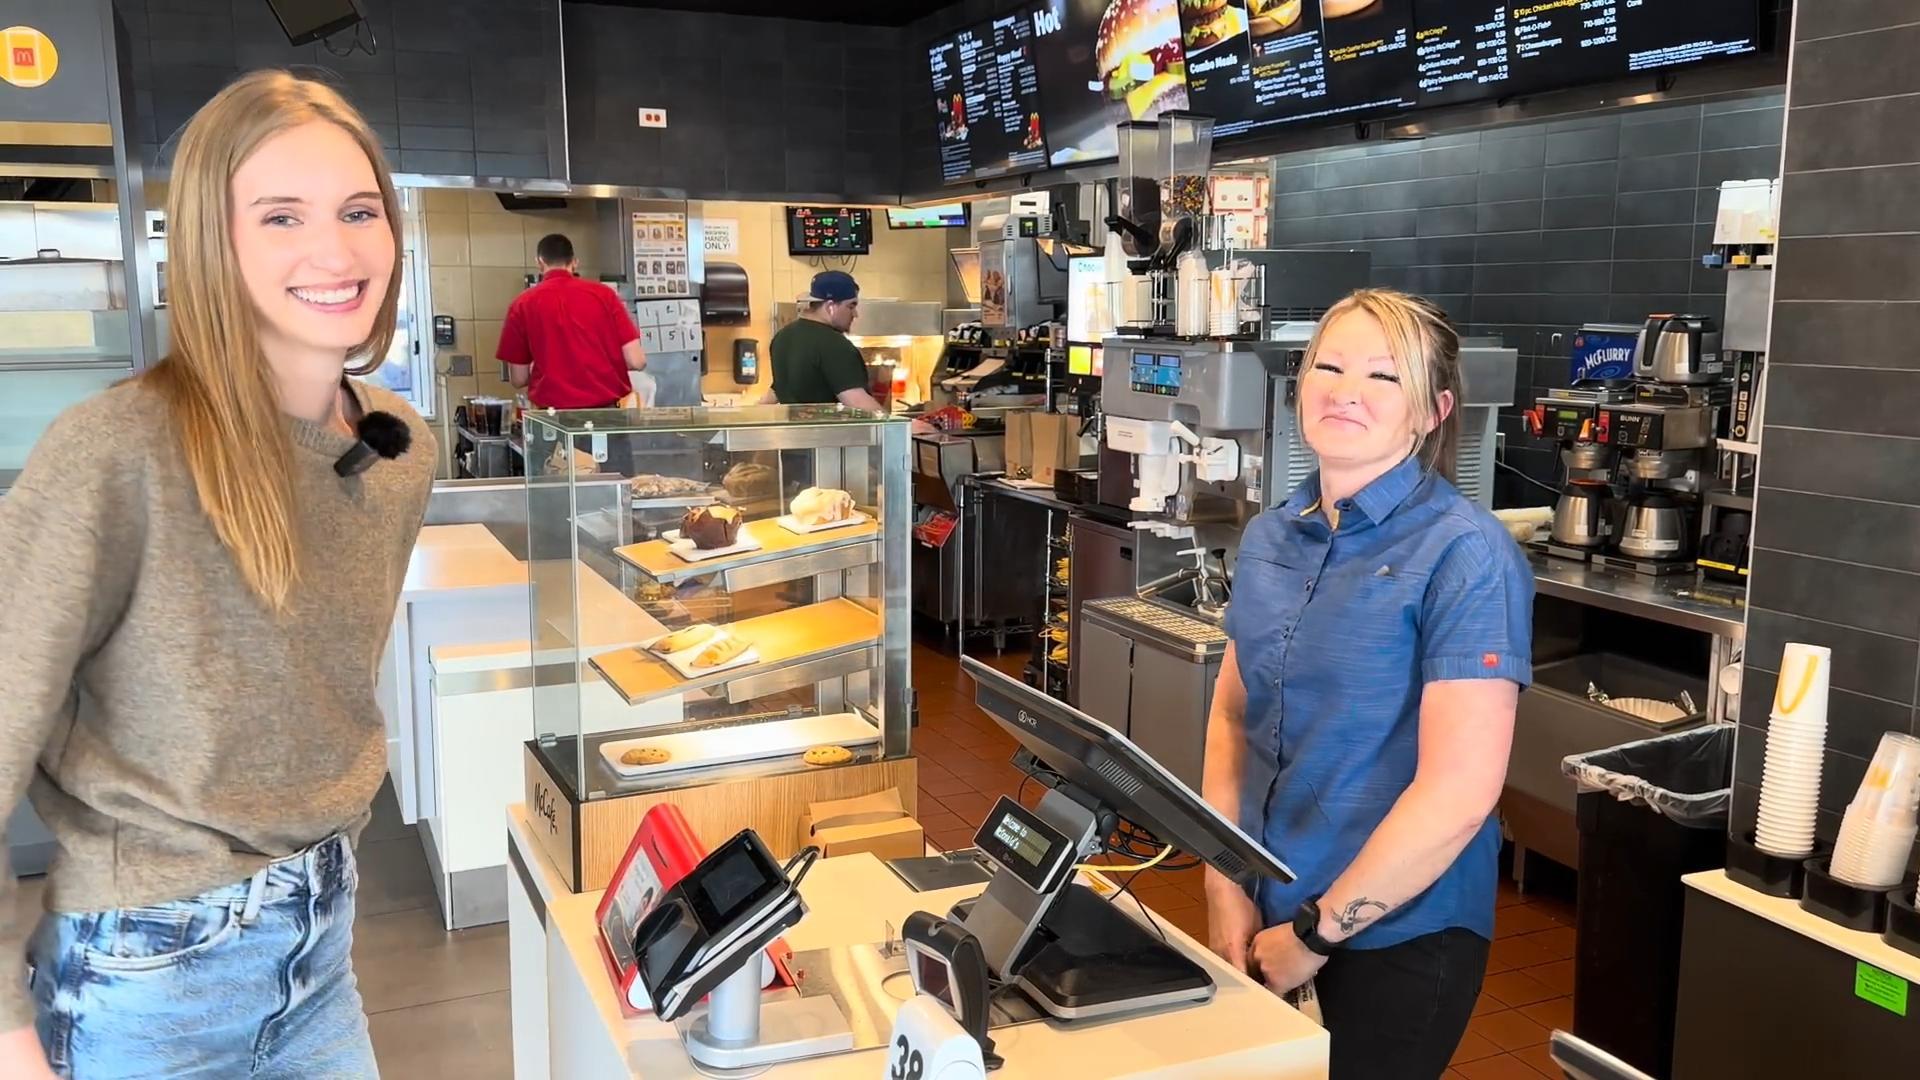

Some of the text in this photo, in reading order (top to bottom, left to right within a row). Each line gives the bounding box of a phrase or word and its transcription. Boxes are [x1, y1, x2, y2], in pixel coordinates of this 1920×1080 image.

[1034, 5, 1062, 38] Hot
[1190, 59, 1215, 74] Combo
[1215, 54, 1238, 68] Meals
[669, 330, 676, 340] 5
